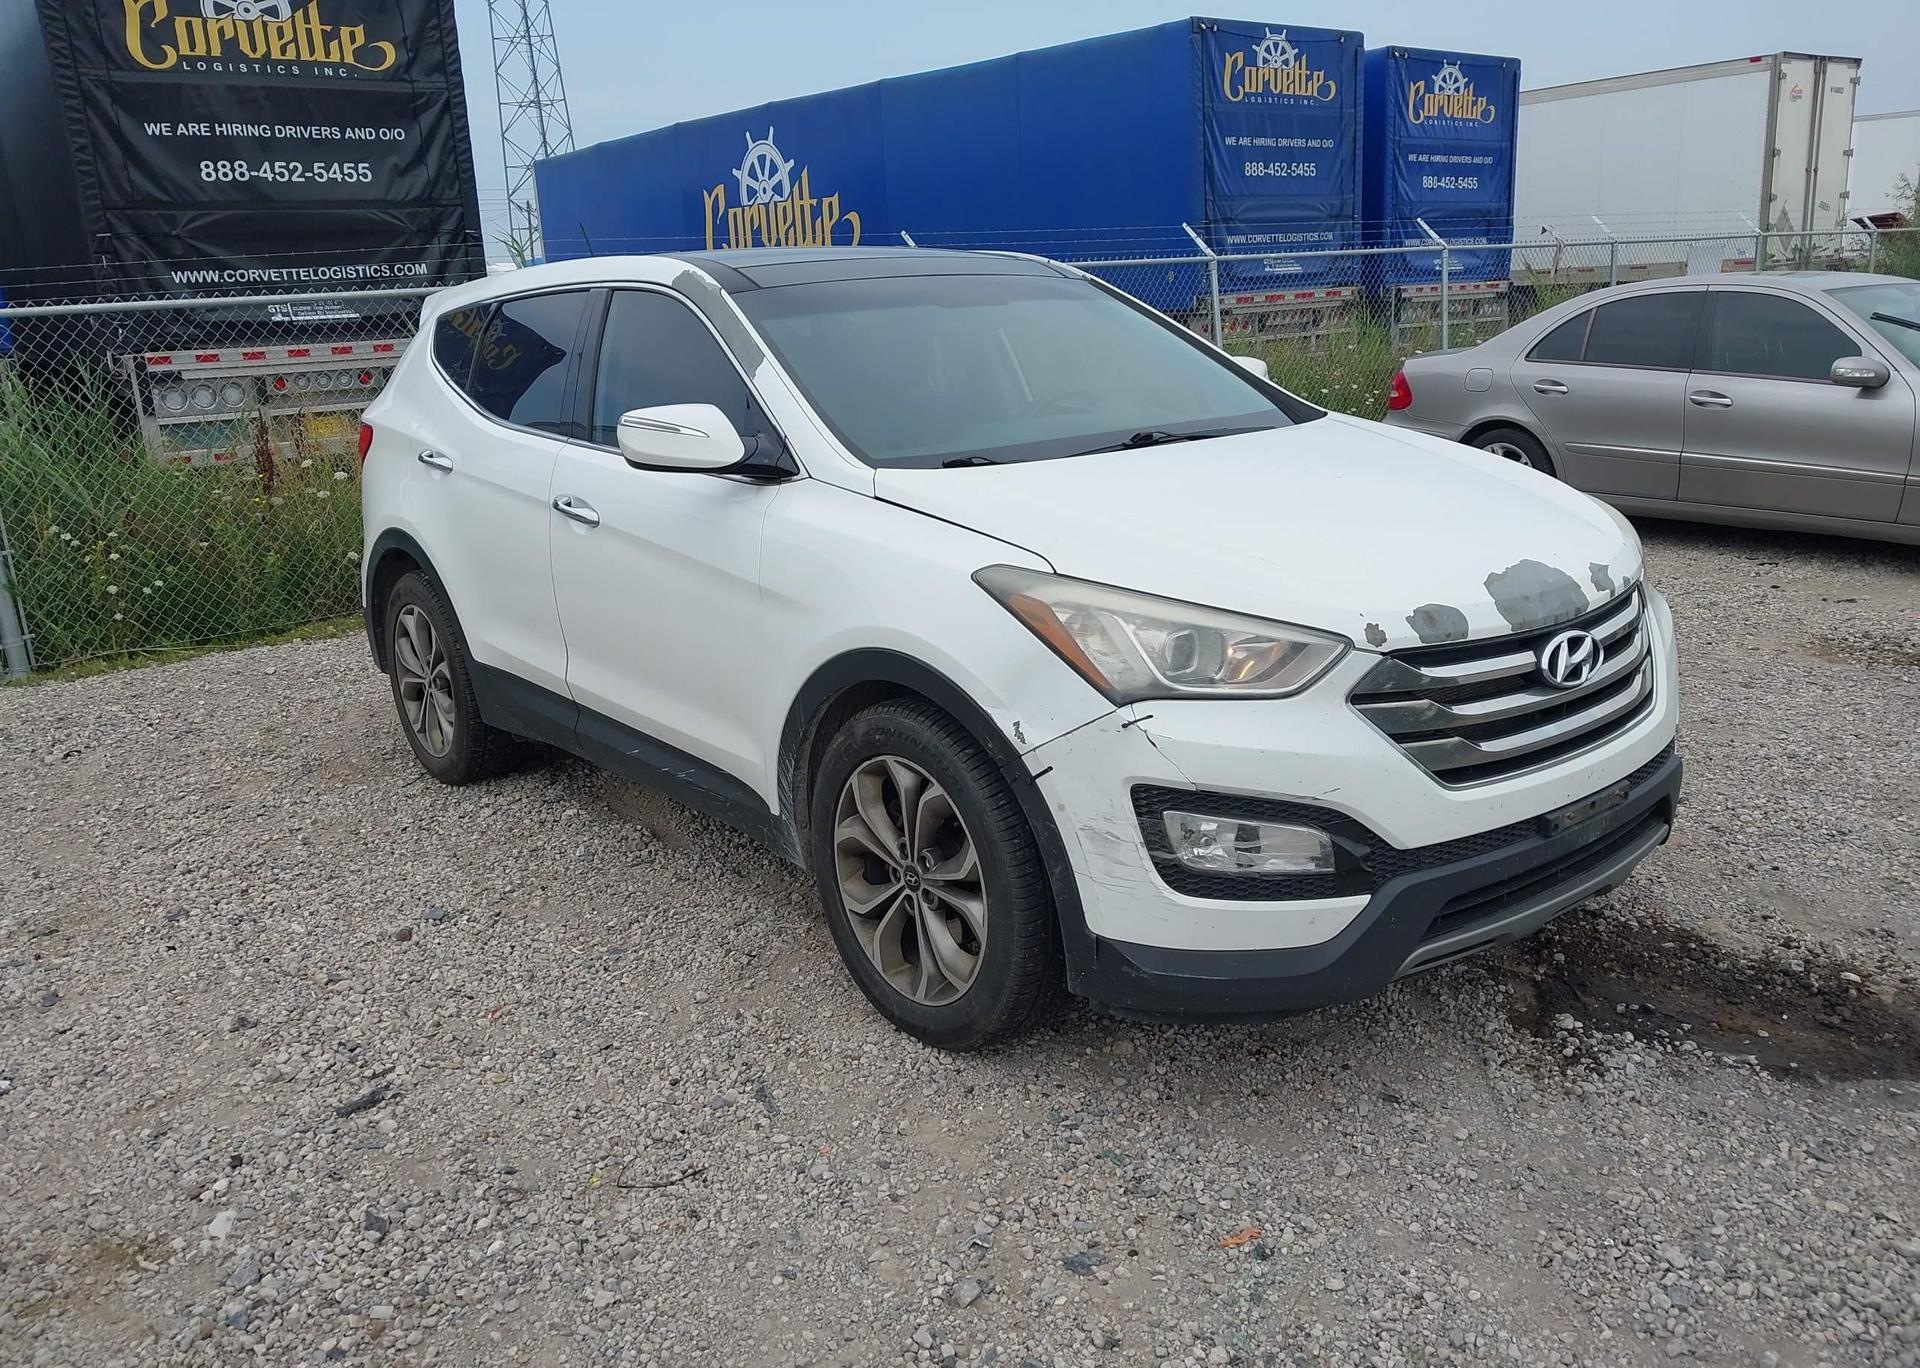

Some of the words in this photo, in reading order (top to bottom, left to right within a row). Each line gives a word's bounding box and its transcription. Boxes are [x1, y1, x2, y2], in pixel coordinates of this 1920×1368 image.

[124, 0, 396, 71] Corvette
[182, 61, 300, 76] LOGISTICS
[314, 66, 358, 78] INC.
[1224, 52, 1336, 101] Corvette
[1245, 96, 1294, 105] LOGISTICS
[1300, 98, 1319, 106] INC.
[1408, 80, 1496, 124] Corvette
[144, 122, 172, 136] WE
[176, 122, 211, 136] ARE
[214, 123, 271, 138] HIRING
[274, 125, 341, 140] DRIVERS
[344, 127, 376, 140] AND
[379, 128, 405, 141] O/O
[1225, 136, 1237, 146] WE
[1239, 137, 1252, 146] ARE
[1252, 137, 1276, 147] HIRING
[1277, 138, 1306, 148] DRIVERS
[1307, 139, 1321, 148] AND
[1408, 153, 1418, 162] WE
[1418, 154, 1430, 162] ARE
[1449, 155, 1472, 164] DRIVERS
[1473, 156, 1484, 164] AND
[200, 160, 372, 182] 888-452-5455
[1245, 162, 1316, 176] 888-452-5455
[1422, 175, 1478, 189] 888-452-5455
[1226, 231, 1334, 244] WWW.CORVETTELOGISTICS.COM
[171, 263, 428, 284] WWW.CORVETTELOGISTICS.COM
[267, 304, 288, 313] GTS
